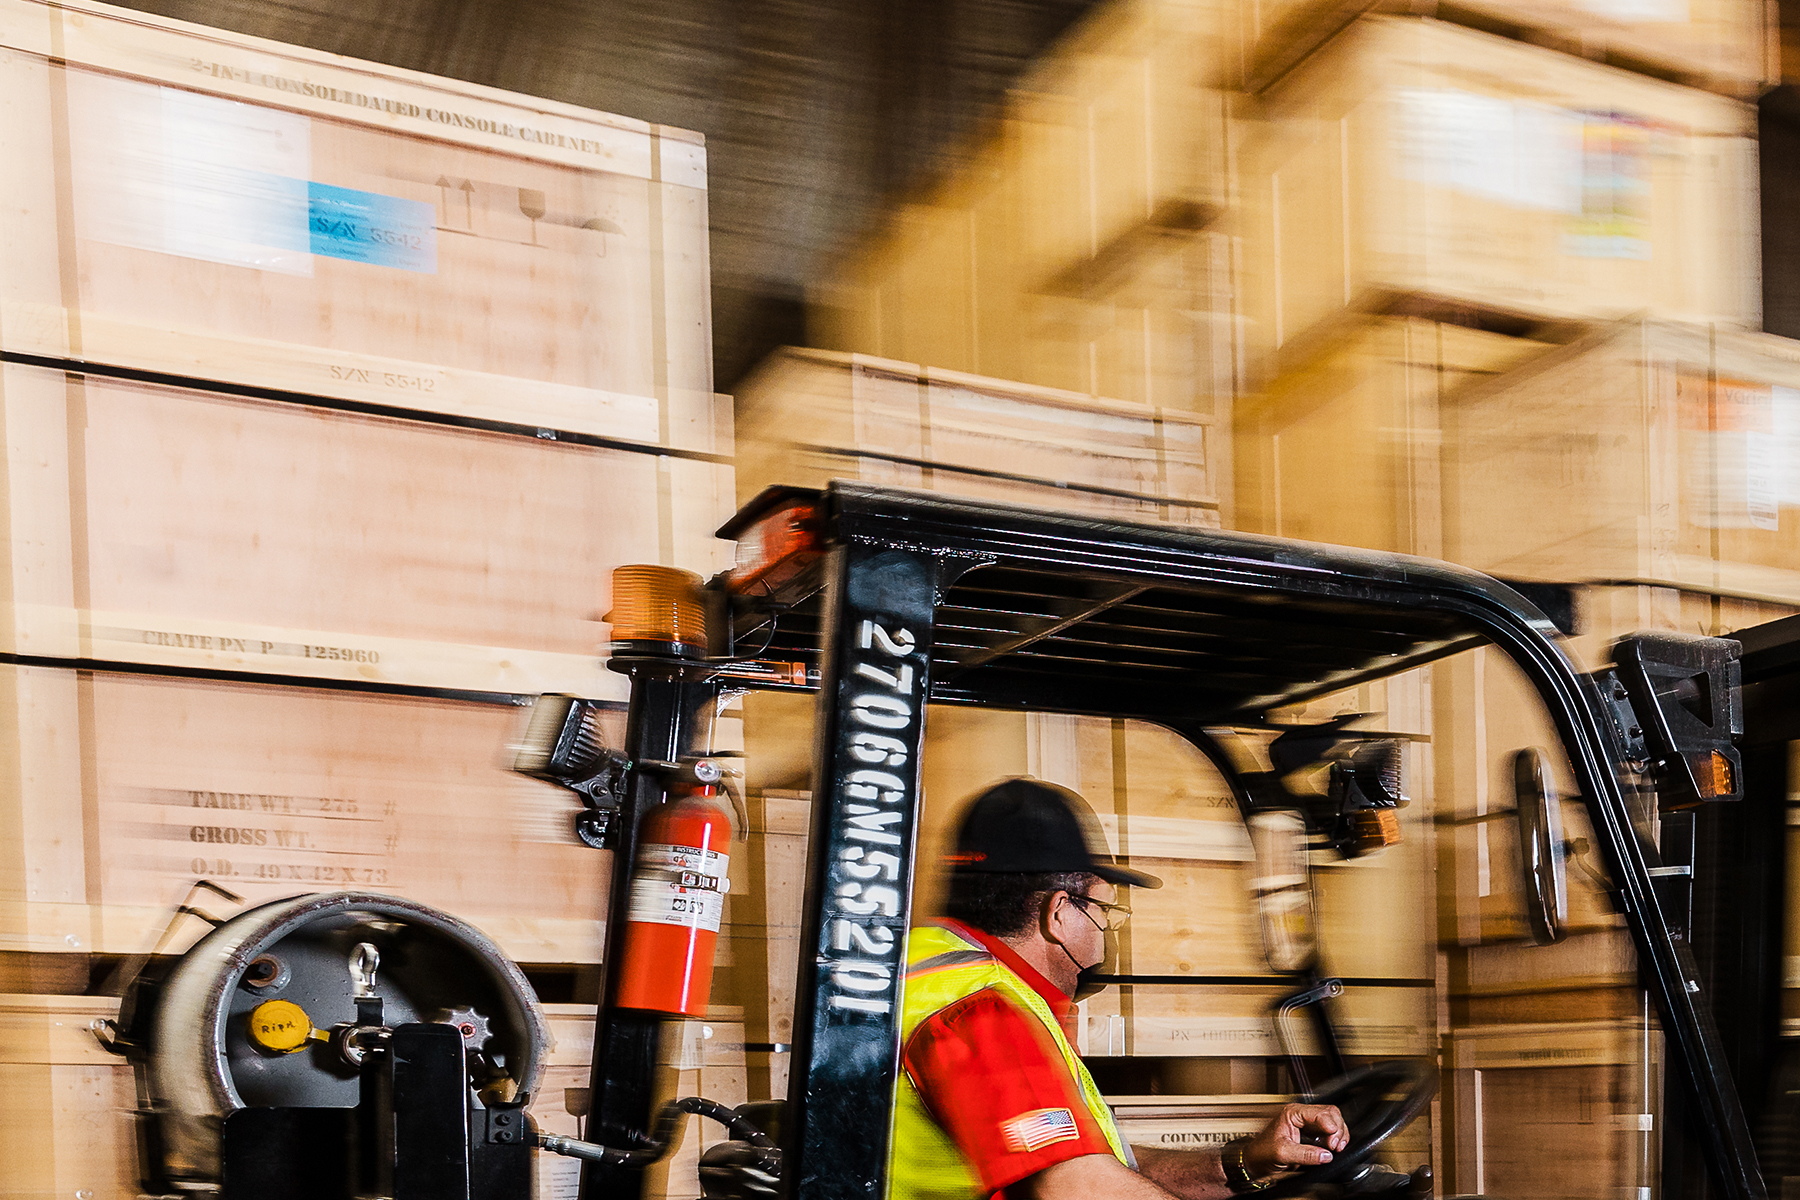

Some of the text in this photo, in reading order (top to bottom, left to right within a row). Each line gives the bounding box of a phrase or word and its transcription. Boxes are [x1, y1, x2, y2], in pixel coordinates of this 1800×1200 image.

[261, 73, 420, 117] CONSOLIDATED
[426, 108, 514, 138] CONSOLE
[519, 126, 604, 155] CABINET
[317, 217, 356, 238] S/N
[330, 365, 435, 392] S/N 5542
[142, 630, 380, 664] CRATE PN P 125960
[188, 790, 251, 811] TARE
[259, 794, 301, 814] WT.
[319, 797, 359, 814] 275
[189, 825, 267, 847] GROSS
[274, 829, 316, 849] WT.
[190, 857, 388, 884] O.D. 49 X 42 X 73
[1170, 1030, 1190, 1042] PN
